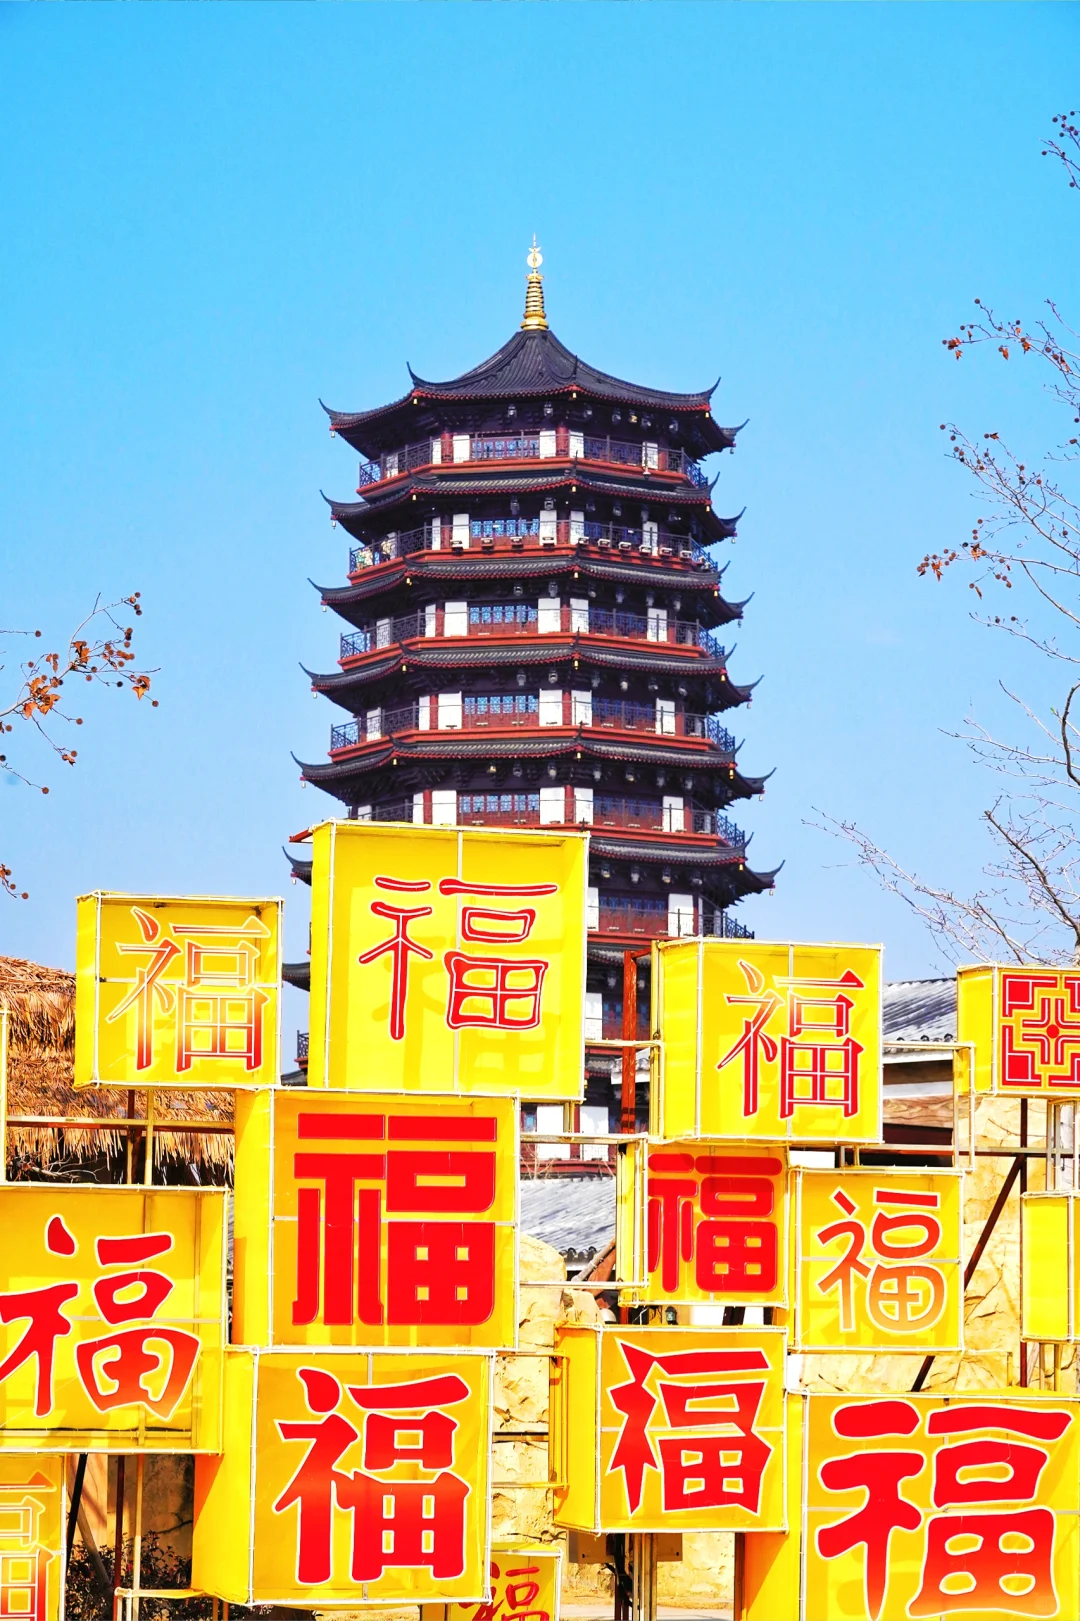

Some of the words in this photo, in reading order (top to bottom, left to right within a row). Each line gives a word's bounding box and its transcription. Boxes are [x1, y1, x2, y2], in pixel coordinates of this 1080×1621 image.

[107, 906, 271, 1072] 福
[359, 876, 558, 1040] 福
[717, 959, 864, 1119] 福
[292, 1113, 497, 1325] 福
[648, 1153, 782, 1293] 福
[817, 1187, 945, 1334] 福
[0, 1215, 201, 1420] 福
[273, 1367, 471, 1584] 福
[605, 1336, 775, 1516] 福
[815, 1400, 1075, 1621] 福
